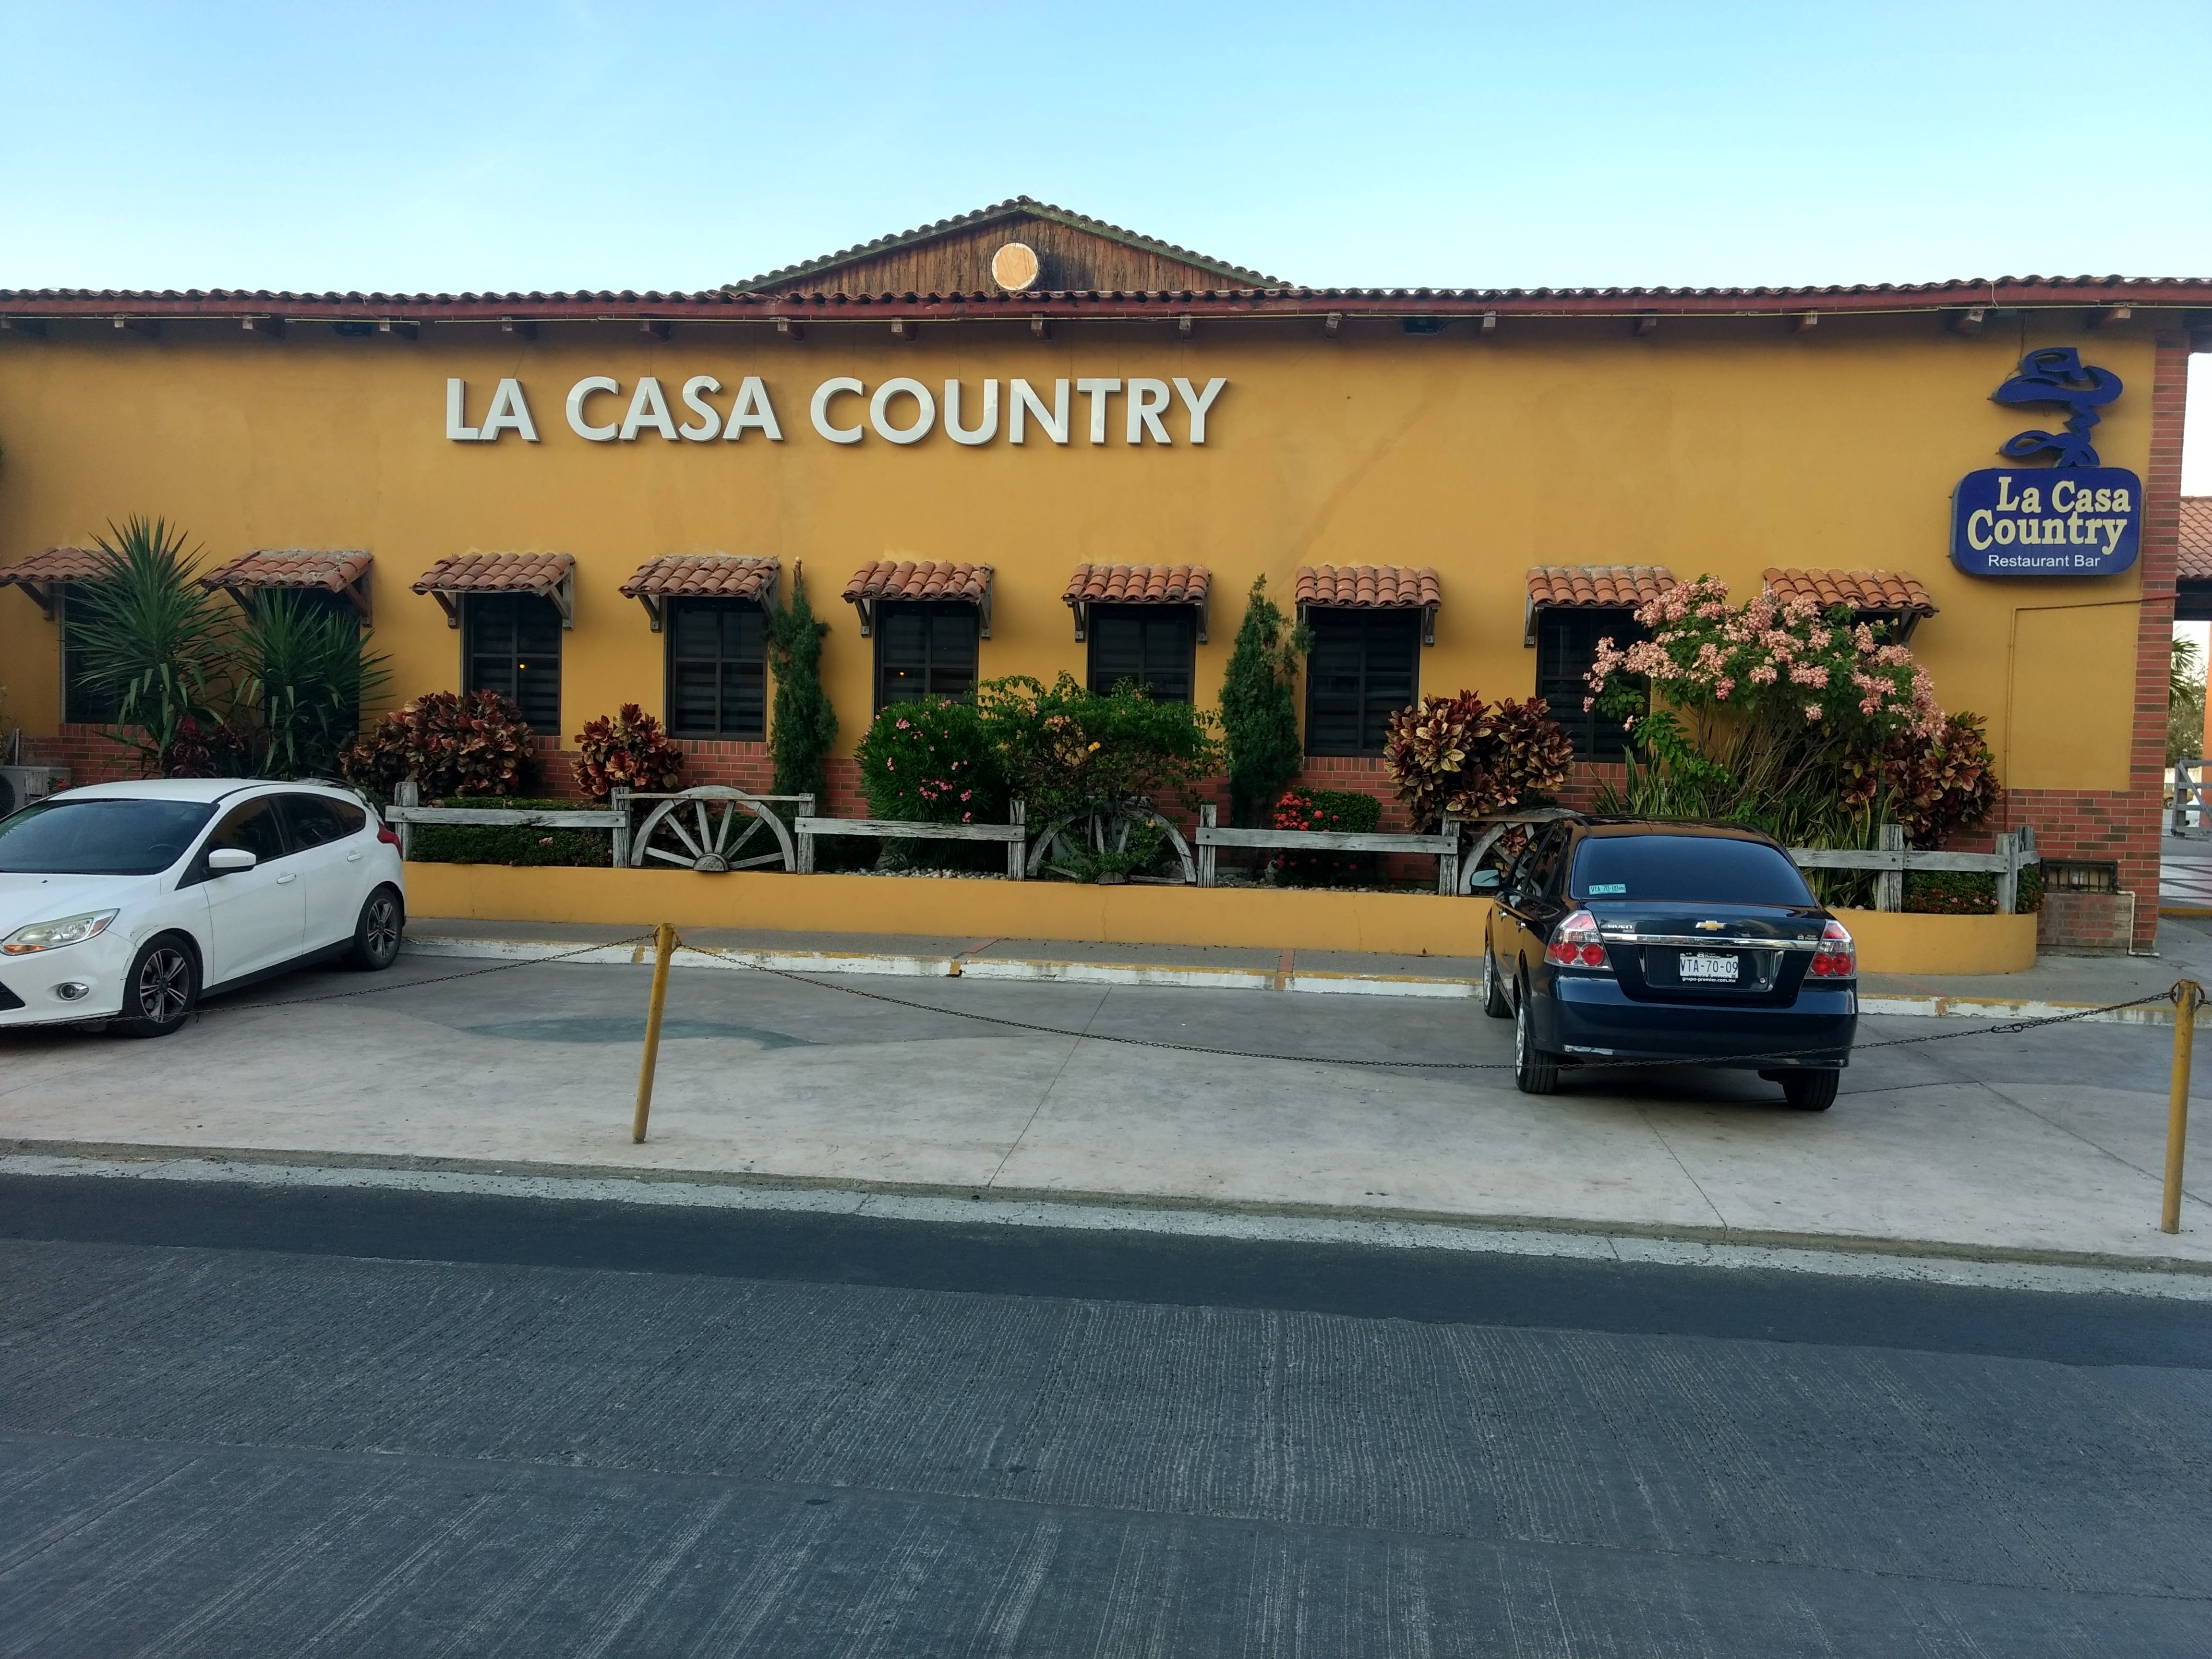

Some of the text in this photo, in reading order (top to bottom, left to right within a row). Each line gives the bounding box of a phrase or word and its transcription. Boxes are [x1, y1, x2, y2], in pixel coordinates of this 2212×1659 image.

[446, 375, 1227, 445] LA CASA COUNTRY
[1996, 476, 2131, 514] La Casa
[1968, 509, 2128, 555] Country
[1988, 555, 2101, 567] Restaurant Bar
[1680, 959, 1738, 974] VTA-70-09
